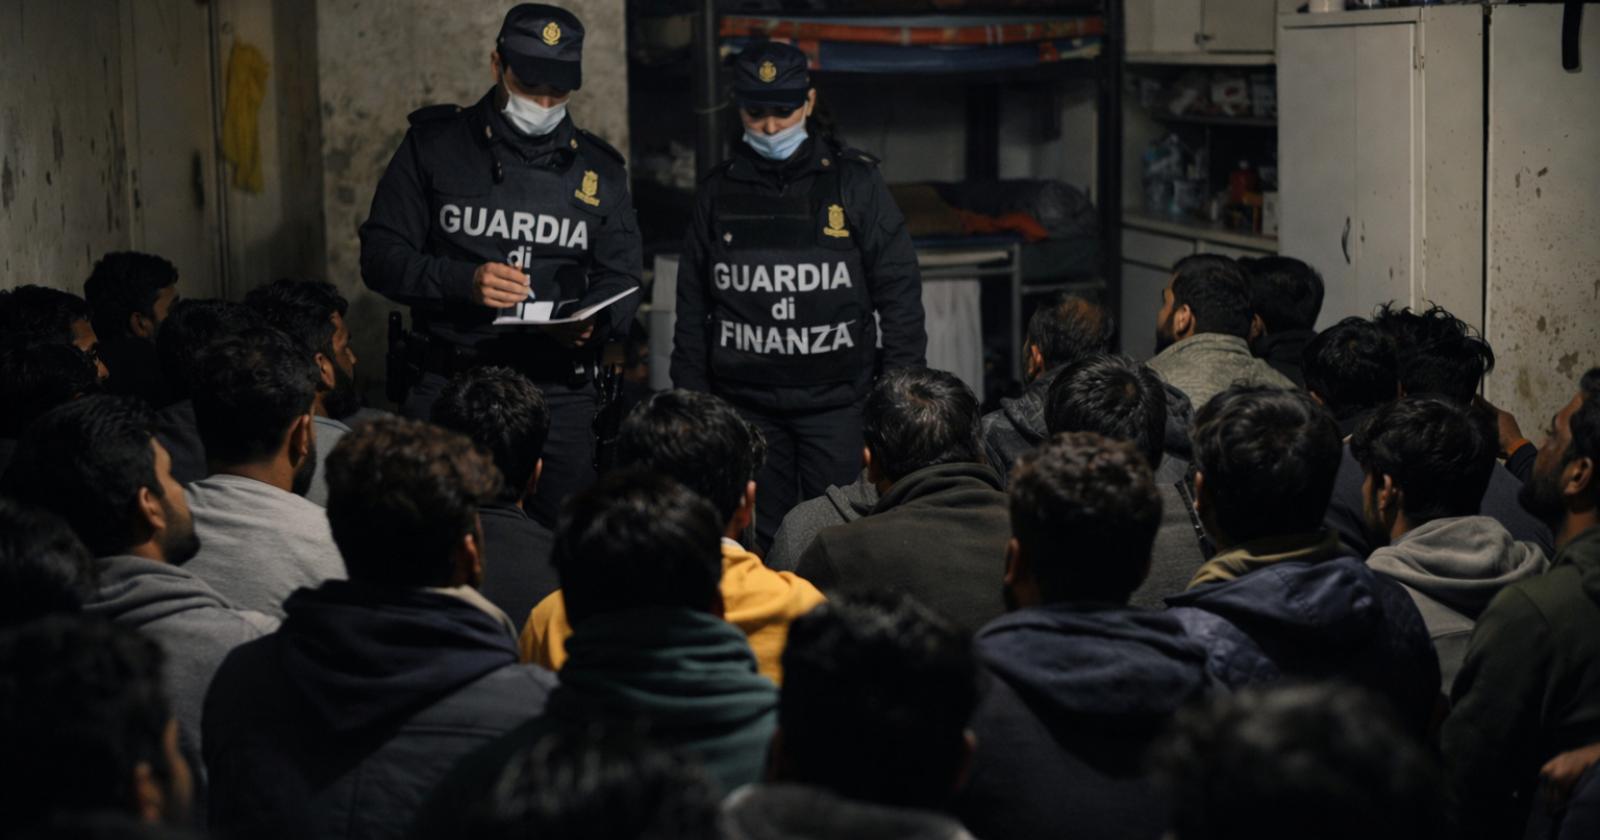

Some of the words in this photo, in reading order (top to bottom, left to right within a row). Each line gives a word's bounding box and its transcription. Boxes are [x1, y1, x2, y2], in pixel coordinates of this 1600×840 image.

[439, 203, 589, 250] GUARDIA
[507, 246, 532, 270] di
[713, 262, 852, 293] GUARDIA
[771, 296, 796, 320] di
[719, 320, 855, 355] FINANZA
